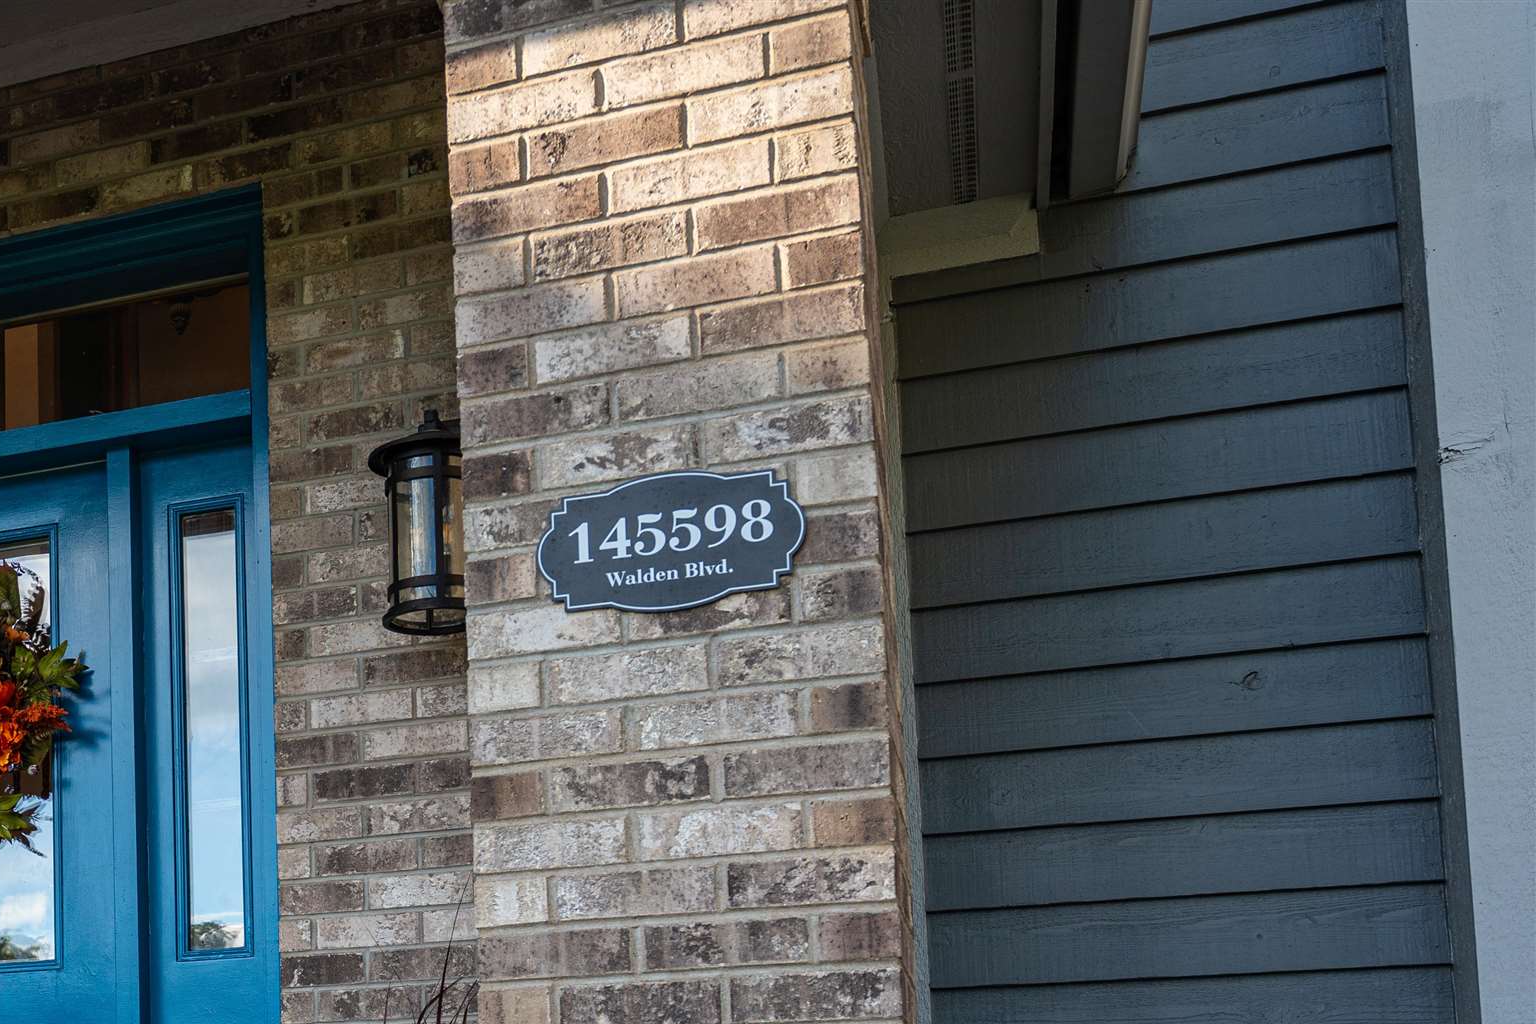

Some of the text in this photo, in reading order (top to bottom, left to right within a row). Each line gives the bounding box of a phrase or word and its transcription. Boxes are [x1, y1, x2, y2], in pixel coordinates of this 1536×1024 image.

[568, 499, 774, 564] 145598
[606, 558, 734, 588] Walden Blvd.
